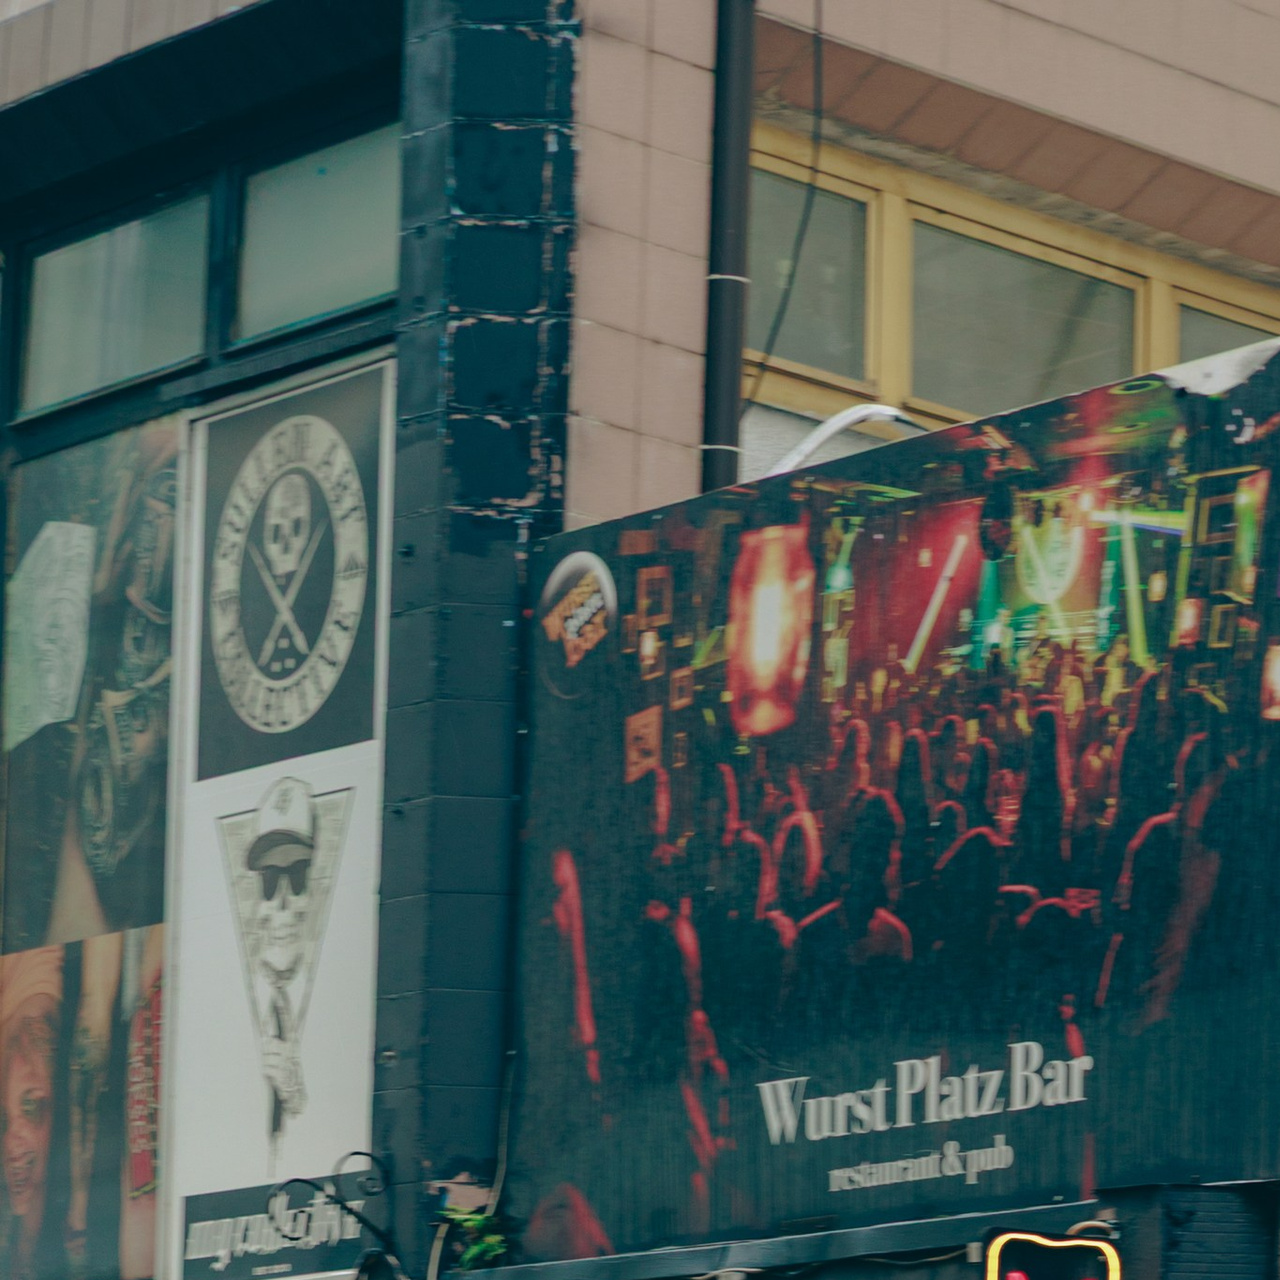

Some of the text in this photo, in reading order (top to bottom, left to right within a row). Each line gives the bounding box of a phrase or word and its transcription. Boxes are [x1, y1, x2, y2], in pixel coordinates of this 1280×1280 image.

[755, 1041, 1094, 1145] Wurst Platz Bar
[828, 1134, 1014, 1192] restaurant & pub
